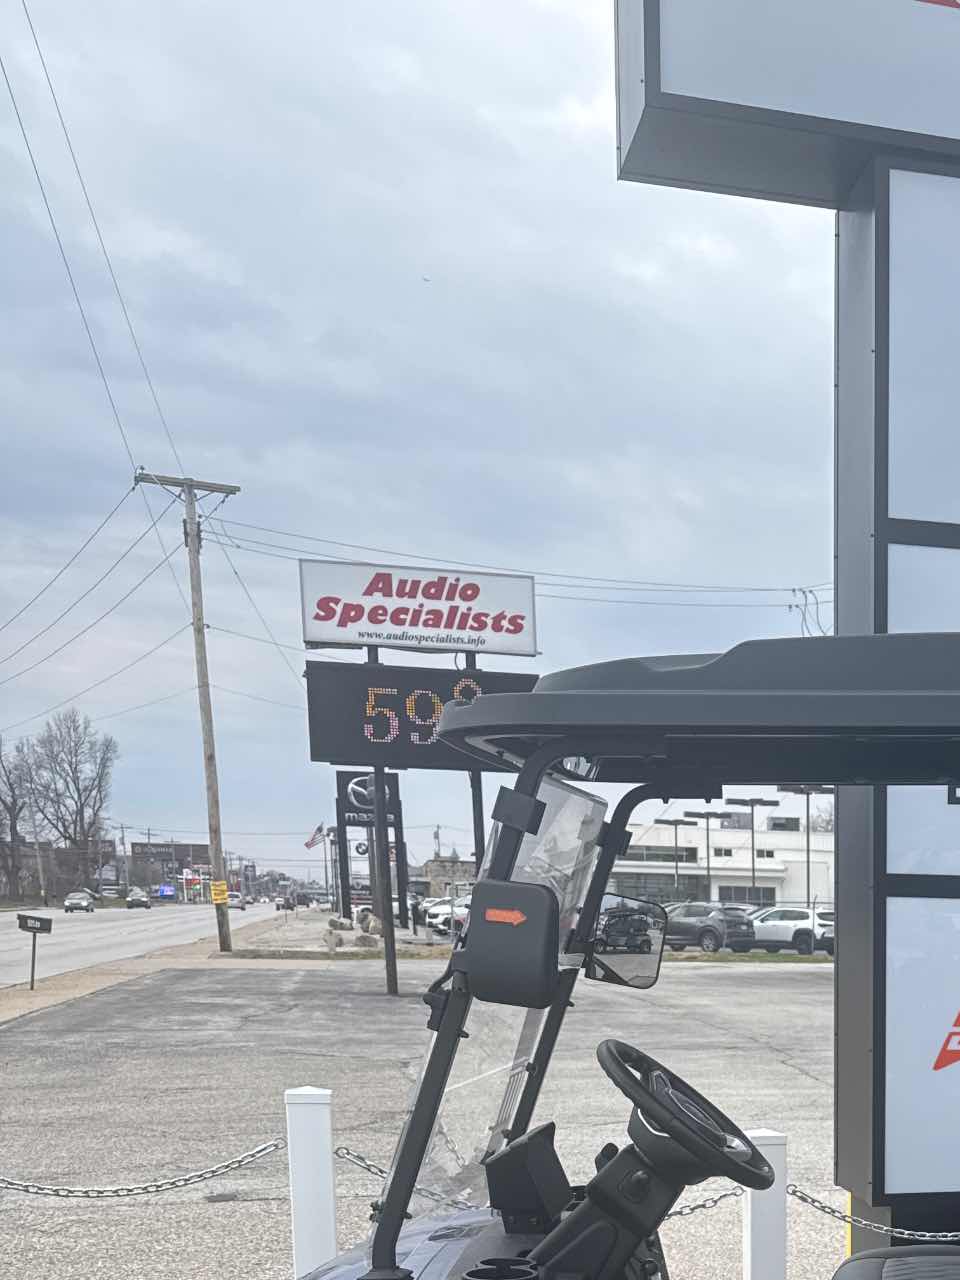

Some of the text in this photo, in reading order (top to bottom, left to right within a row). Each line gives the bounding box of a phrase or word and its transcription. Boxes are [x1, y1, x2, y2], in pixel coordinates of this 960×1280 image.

[362, 571, 481, 602] Audio
[312, 595, 526, 635] Specialists
[357, 630, 486, 647] www.audiospecialists.info
